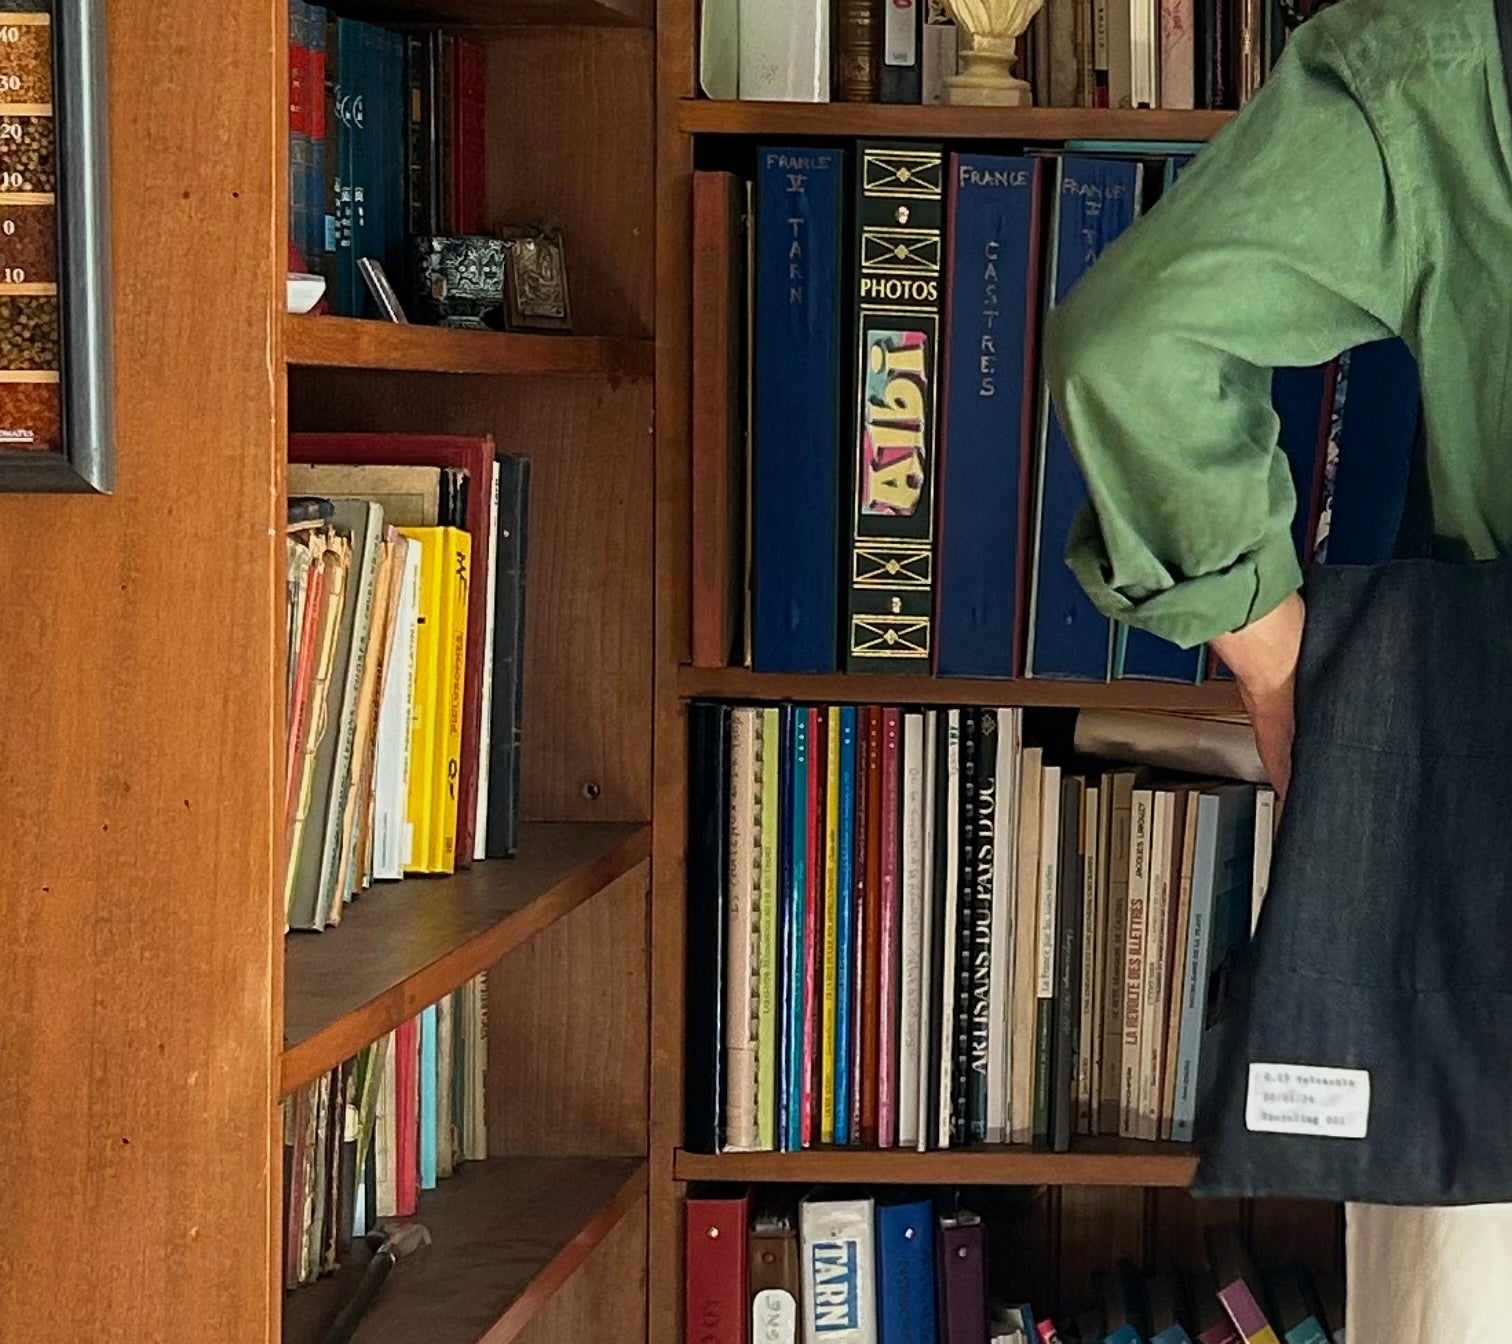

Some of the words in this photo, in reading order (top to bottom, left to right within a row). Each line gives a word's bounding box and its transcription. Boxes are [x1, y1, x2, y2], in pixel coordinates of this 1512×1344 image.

[1, 122, 22, 140] 20
[765, 155, 830, 172] FRANCE
[2, 171, 24, 188] 10
[959, 165, 1030, 189] FRANCE
[3, 220, 15, 235] 0
[5, 268, 25, 285] 10
[860, 276, 939, 302] PHOTOS
[978, 241, 999, 399] CASTRES
[975, 776, 995, 837] D'OC
[974, 844, 993, 900] PAYS
[972, 908, 992, 944] DU
[1126, 957, 1142, 981] DES
[971, 950, 990, 1075] ARTISANS
[1124, 1029, 1138, 1046] LA
[814, 1241, 848, 1327] TARN
